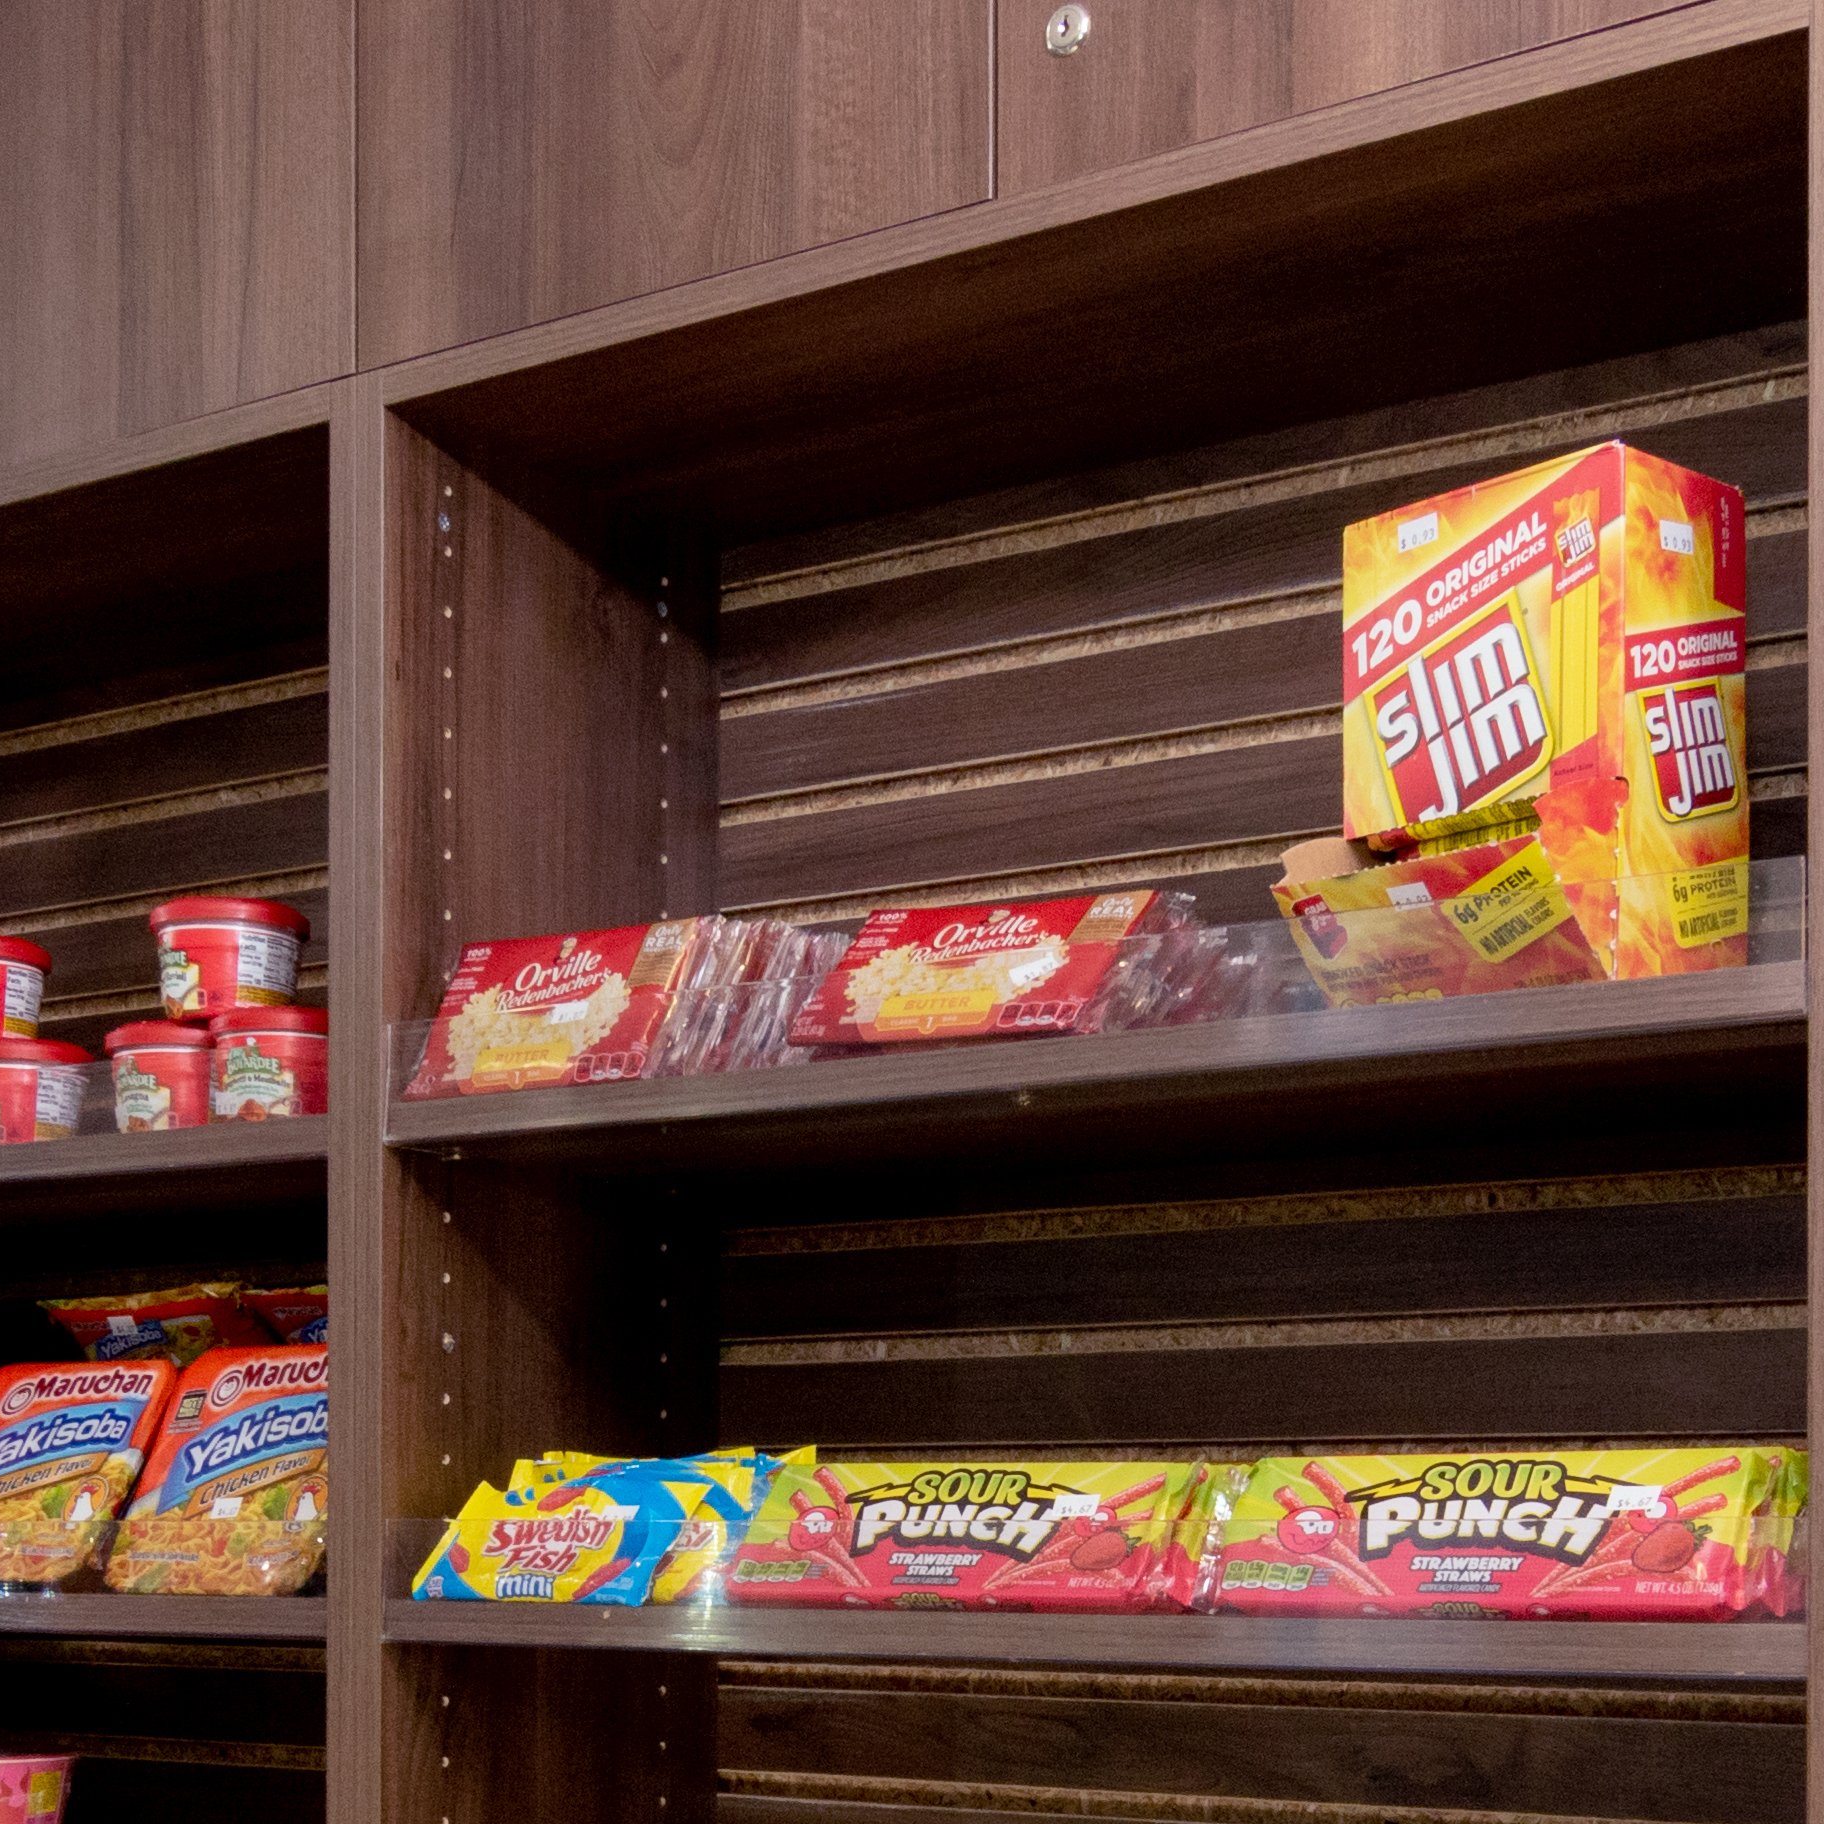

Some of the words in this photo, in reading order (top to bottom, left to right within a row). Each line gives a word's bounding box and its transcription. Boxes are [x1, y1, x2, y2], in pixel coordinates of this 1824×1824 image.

[1427, 513, 1546, 606] ORIGINAL
[1427, 594, 1469, 628] SNACK
[1470, 576, 1496, 601] SIZE
[1499, 538, 1546, 581] STICKS
[1352, 599, 1421, 678] 120
[1631, 641, 1674, 678] 120
[1678, 629, 1737, 657] ORIGINAL
[936, 915, 1038, 945] Orville
[910, 931, 1049, 964] Redenbacher's
[516, 949, 601, 991] Orville
[495, 971, 611, 1013] Redenbacher's
[34, 1368, 155, 1398] Maruchan
[55, 1459, 94, 1478] Flavor
[1420, 1462, 1561, 1500] SOUR
[908, 1472, 1027, 1504] SOUR
[856, 1502, 1060, 1557] PUNCH
[1366, 1497, 1609, 1556] PUNCH
[500, 1541, 578, 1571] Fish
[888, 1552, 981, 1568] STRAWBERRY
[908, 1566, 954, 1577] STRAWS
[1411, 1557, 1523, 1571] STRAWBERRY
[495, 1574, 553, 1599] mini
[1434, 1571, 1491, 1582] STRAWS
